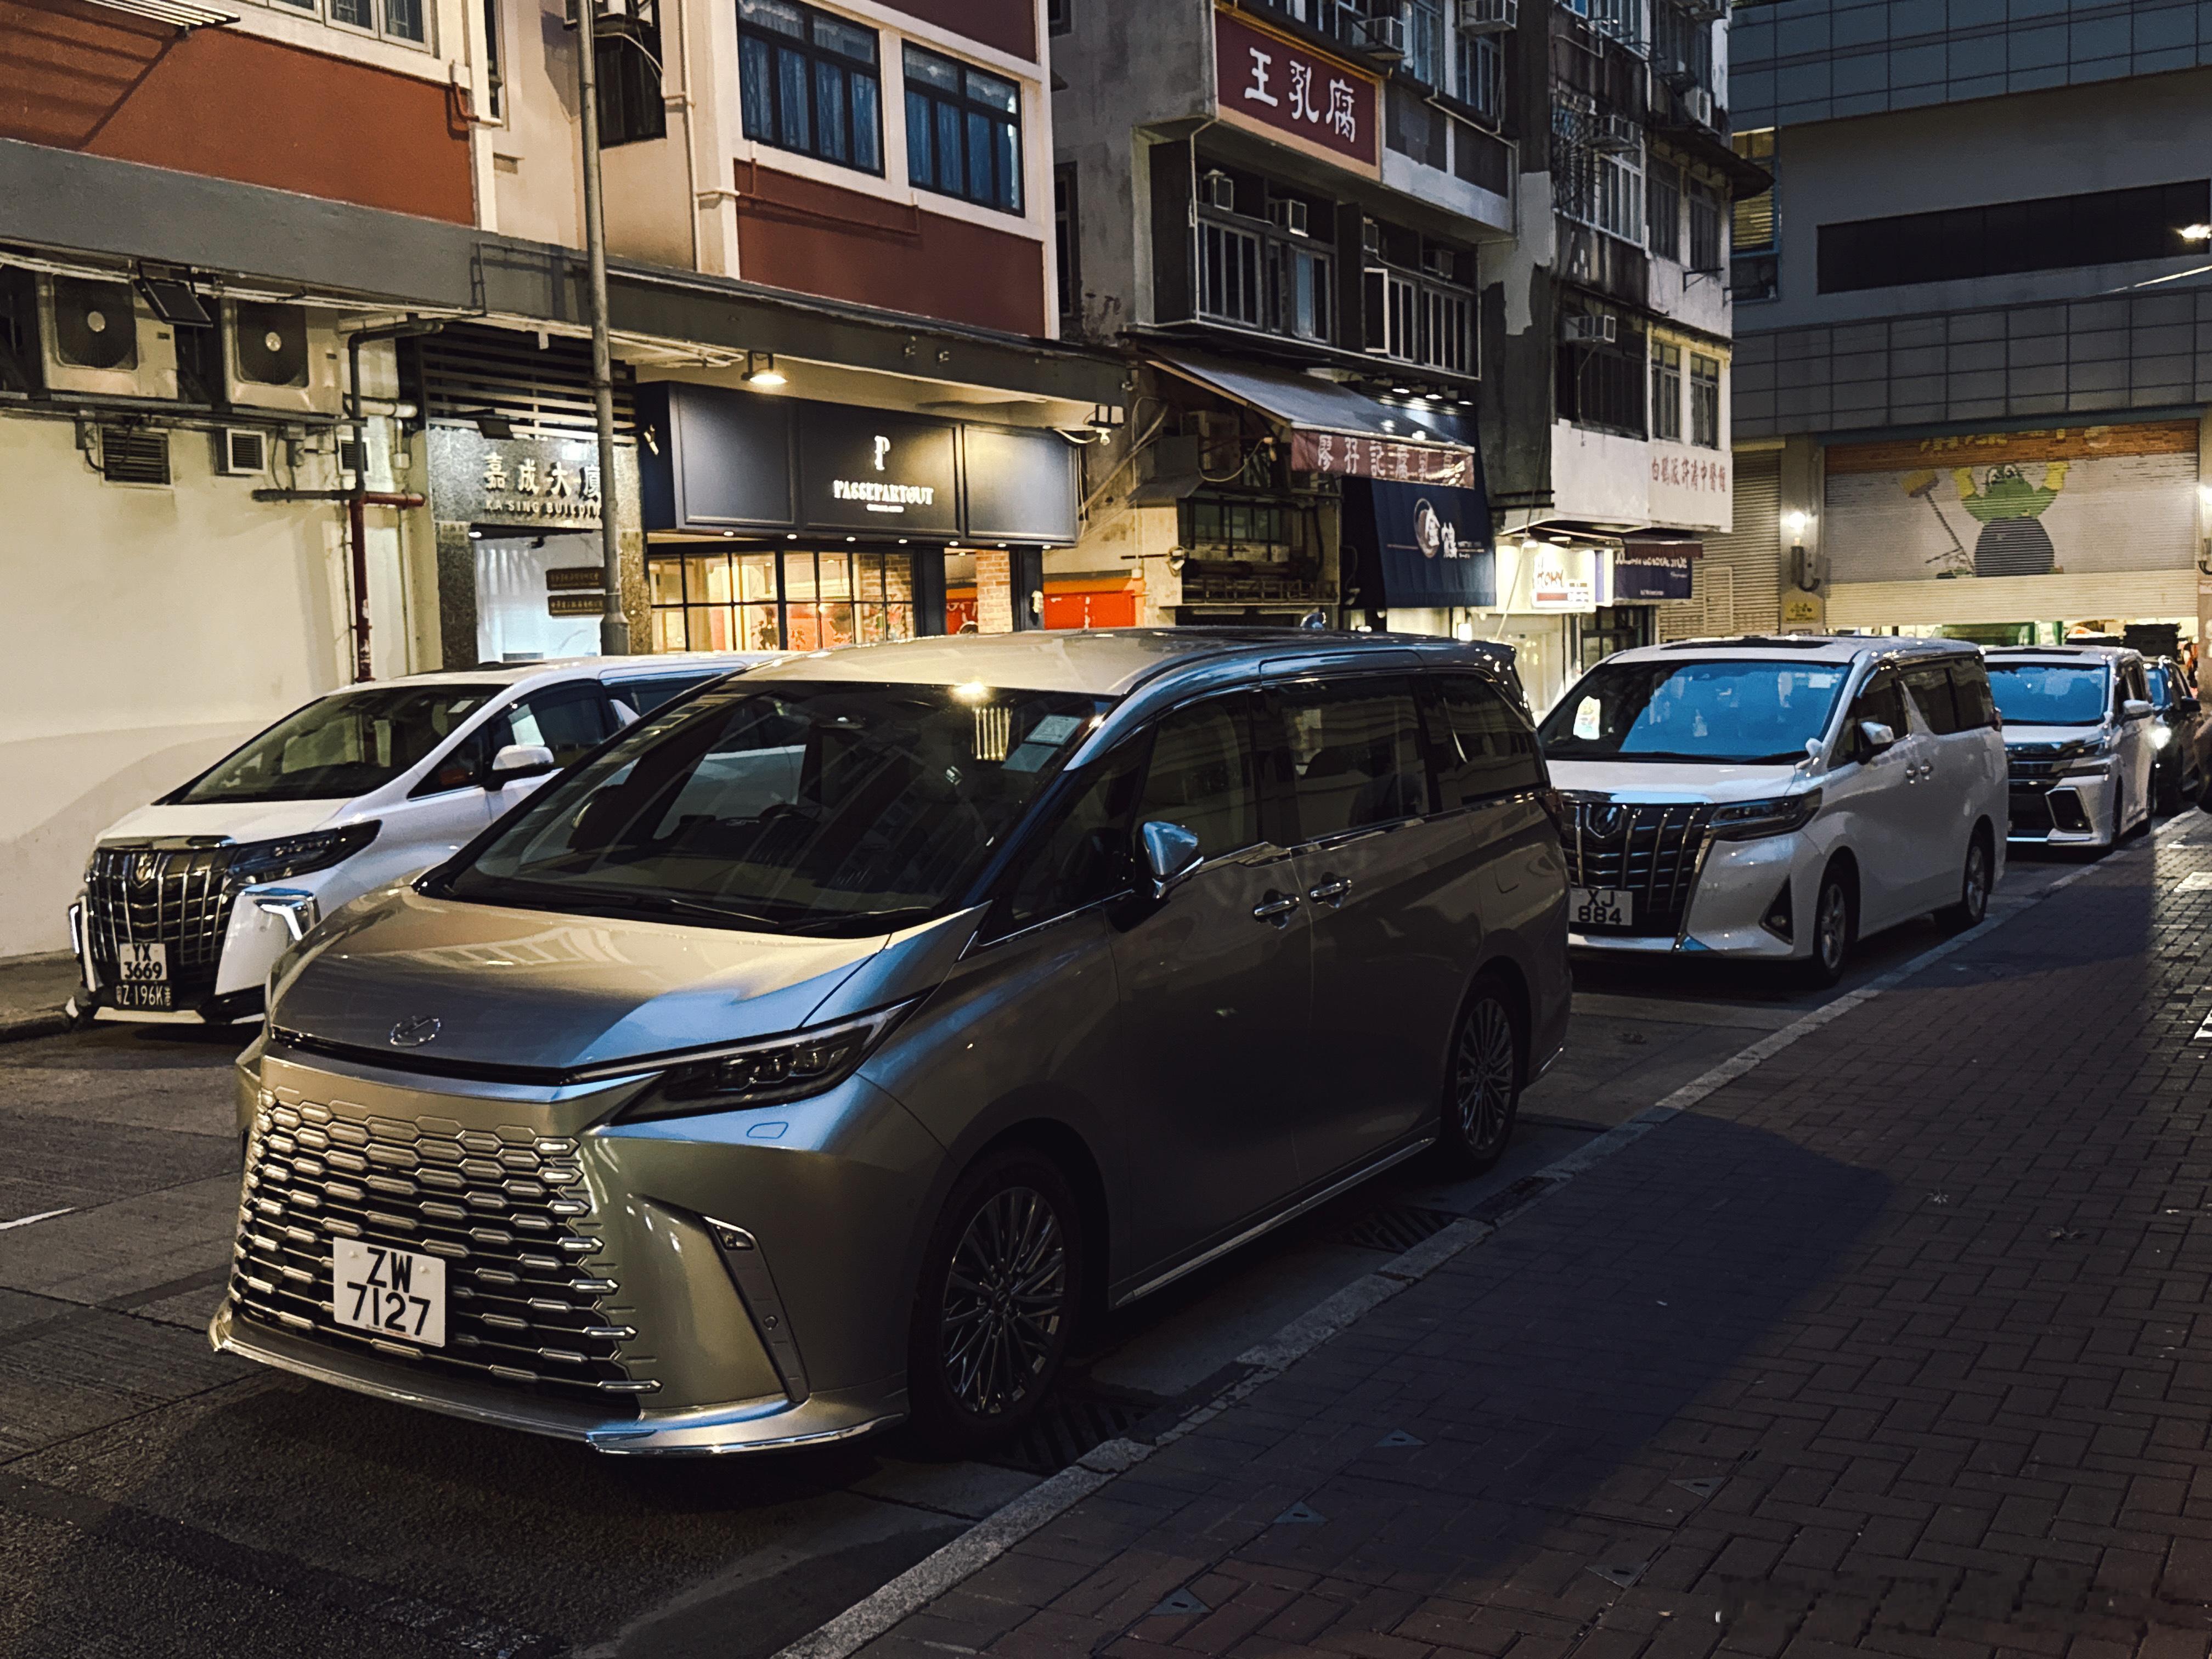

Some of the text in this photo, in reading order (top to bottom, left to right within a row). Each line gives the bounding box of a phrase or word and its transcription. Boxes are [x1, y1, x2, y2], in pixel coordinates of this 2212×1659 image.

[486, 500, 503, 511] KA
[508, 500, 540, 514] SING
[1587, 889, 1616, 907] XJ
[1577, 905, 1622, 925] 884
[133, 944, 152, 961] YX
[123, 961, 163, 979] 3669
[366, 1246, 413, 1294] ZW
[346, 1281, 431, 1336] 7127
